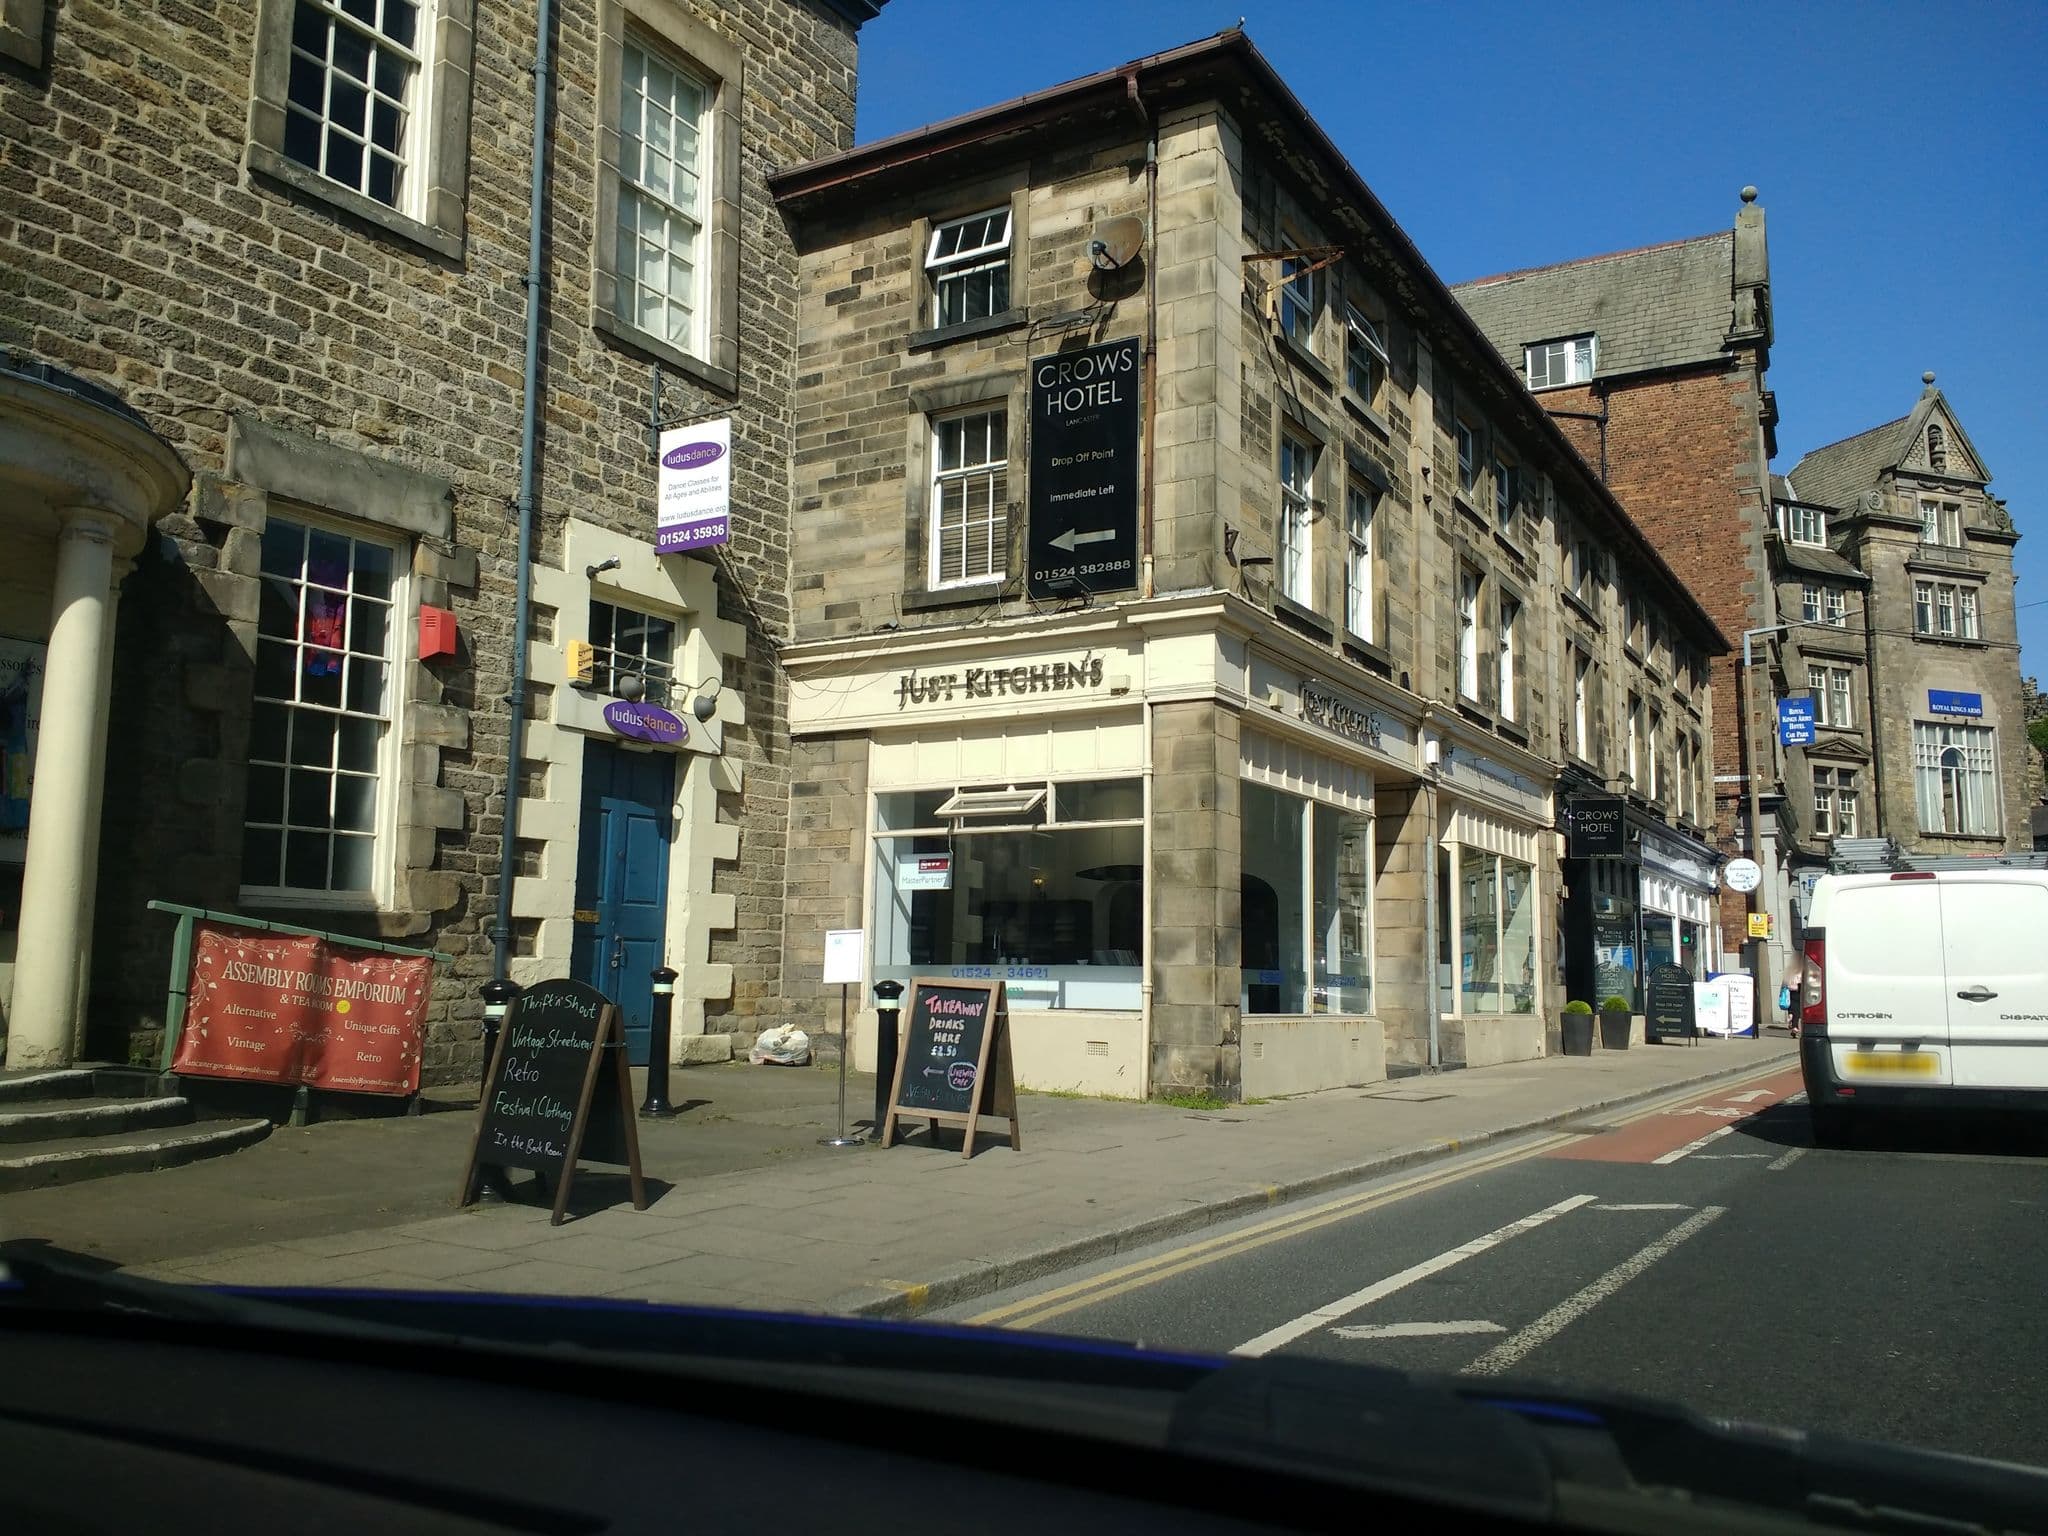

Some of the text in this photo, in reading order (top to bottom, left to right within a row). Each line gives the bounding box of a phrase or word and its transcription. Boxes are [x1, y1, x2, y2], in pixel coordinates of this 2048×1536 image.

[1037, 347, 1132, 388] CROWS
[1047, 379, 1123, 416] HOTEL
[667, 447, 717, 465] ludusdance
[1051, 448, 1114, 467] Drop Off Point
[1050, 484, 1115, 503] Immediate Left
[660, 524, 725, 546] 01524 35936
[1034, 559, 1131, 582] 01524 382888
[611, 706, 677, 734] ludusdance
[1576, 810, 1619, 820] CROWS
[1580, 823, 1615, 833] HOTEL
[951, 966, 992, 979] 01524
[221, 959, 408, 1006] ASSEMBLY ROOMS EMPORIUM
[279, 993, 289, 1005] &
[290, 994, 310, 1007] TEA
[564, 994, 599, 1020] Shout
[925, 995, 984, 1018] TAKEAWAY
[222, 1003, 278, 1021] Alternative
[1836, 1012, 1893, 1020] CITROËN
[344, 1019, 401, 1036] Unique Gifts
[929, 1016, 966, 1031] DRINKS
[227, 1036, 267, 1052] Vintage
[512, 1023, 596, 1060] Vintage Streetwear
[933, 1033, 962, 1045] HERE
[357, 1050, 383, 1064] Retro
[930, 1045, 957, 1058] £2.50
[504, 1056, 540, 1083] Retro
[493, 1090, 574, 1133] Festival Clothing
[510, 1134, 524, 1149] the
[525, 1137, 545, 1155] Back
